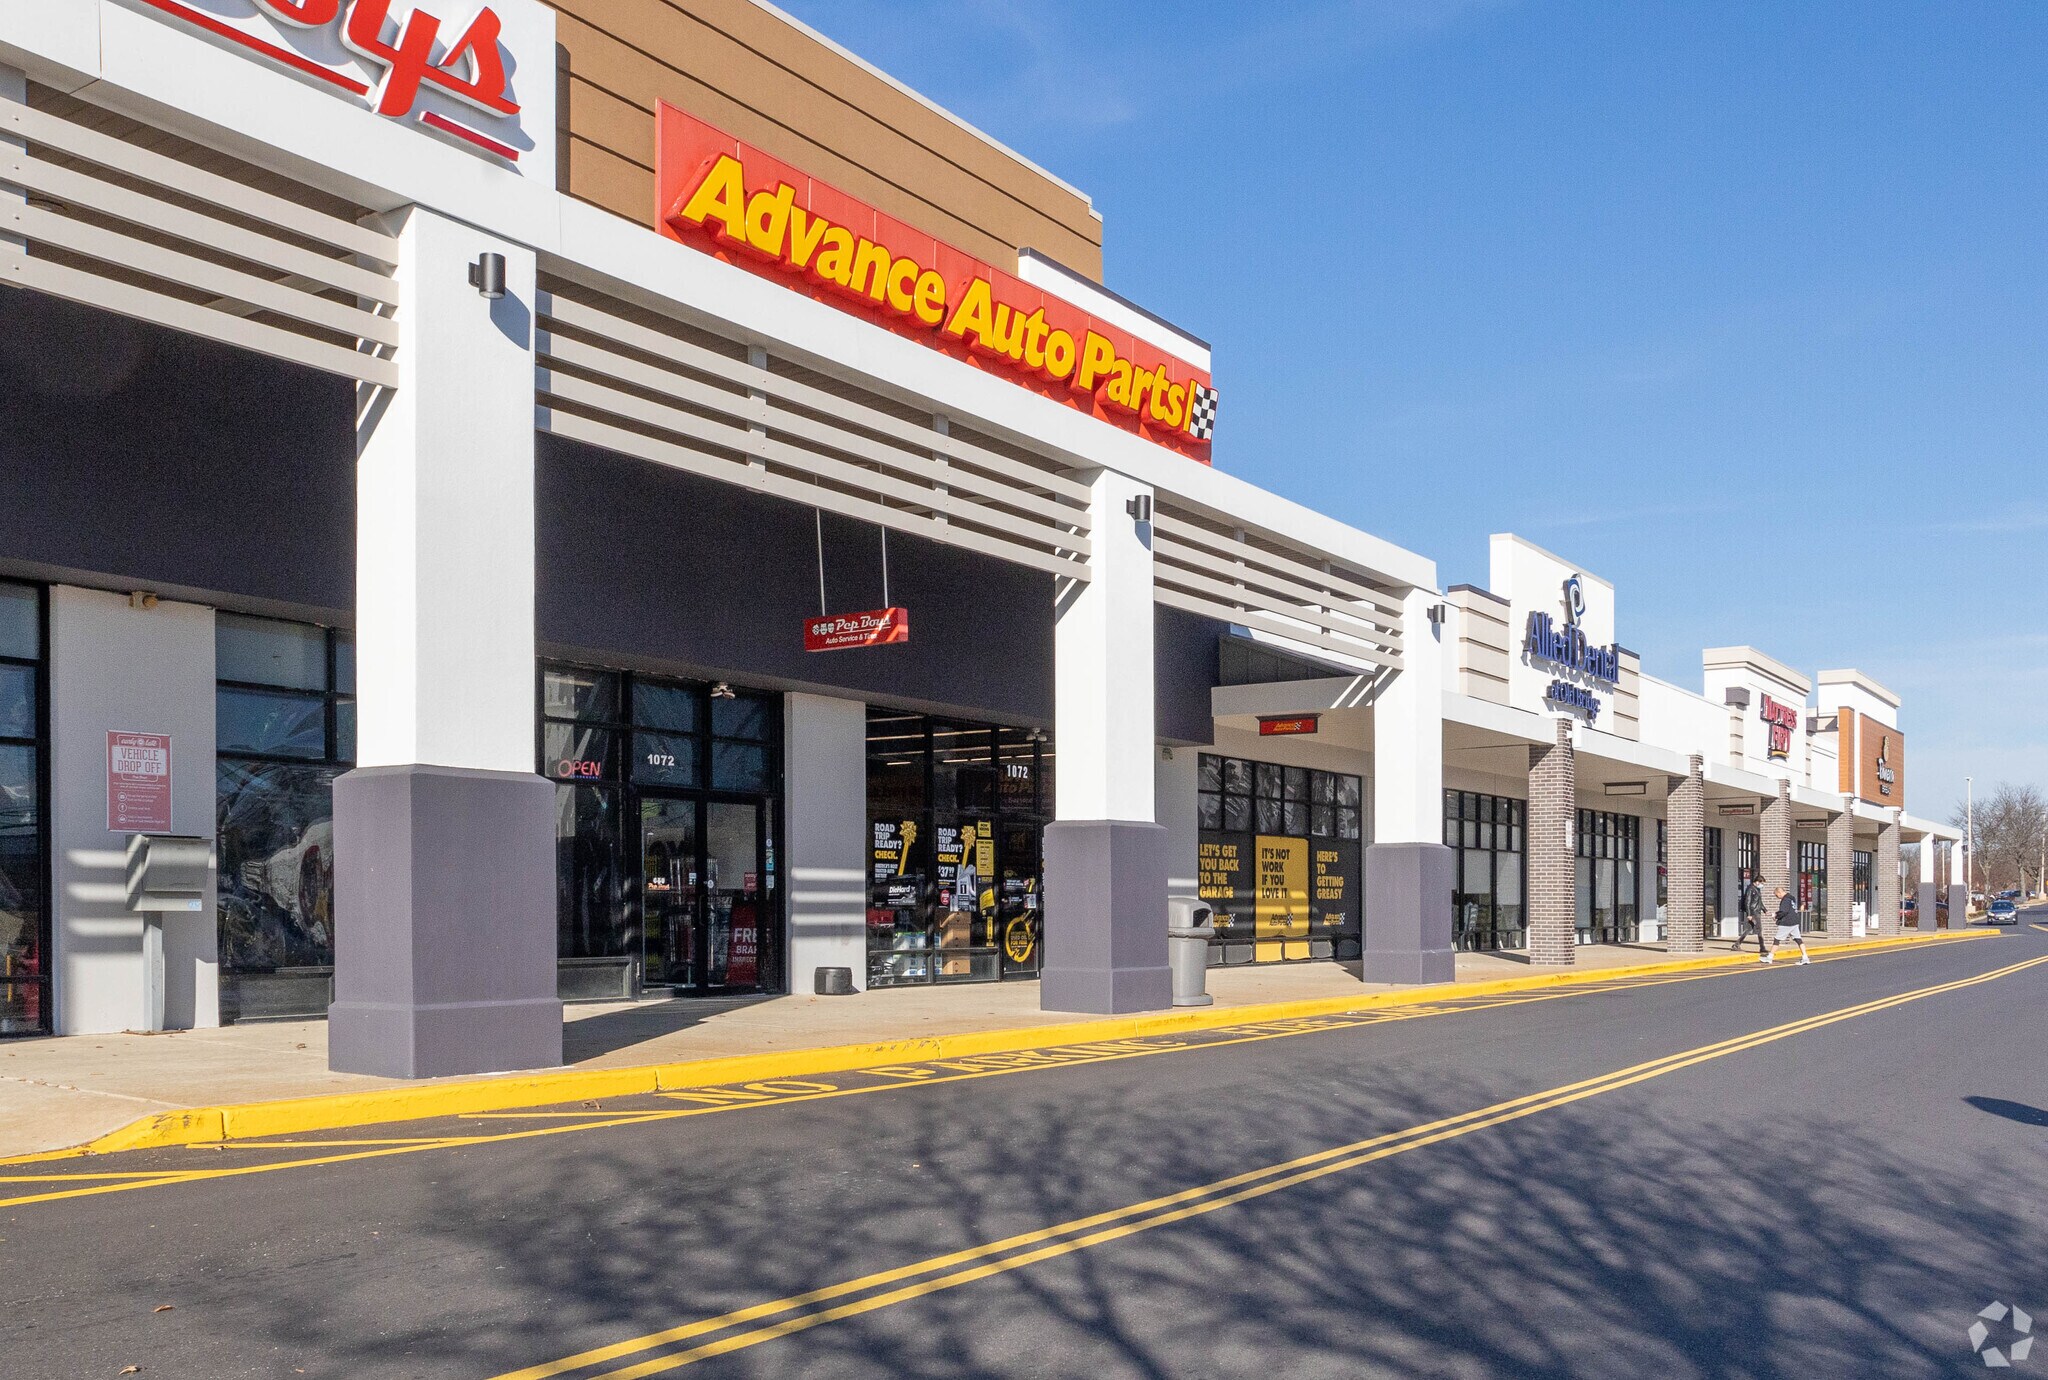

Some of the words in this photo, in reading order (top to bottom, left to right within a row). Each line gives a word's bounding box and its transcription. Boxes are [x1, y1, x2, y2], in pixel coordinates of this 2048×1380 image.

[682, 154, 947, 325] Advance
[948, 277, 1077, 380] Auto
[1079, 330, 1186, 426] Parts
[836, 618, 859, 632] Pep
[860, 615, 892, 631] Boys
[825, 636, 838, 645] Auto
[838, 633, 858, 643] Service
[1529, 611, 1573, 668] Allied
[1575, 627, 1619, 684] Dental
[120, 747, 159, 761] VEHICLE
[647, 753, 675, 767] 1072
[117, 759, 142, 772] DROP
[144, 761, 161, 773] OFF
[558, 759, 602, 777] OPEN
[1006, 764, 1029, 778] 1072
[874, 823, 896, 833] ROAD
[937, 827, 957, 837] ROAD
[874, 832, 891, 840] TRIP
[937, 836, 953, 845] TRIP
[874, 840, 903, 850] READY?
[937, 844, 963, 853] READY?
[1199, 844, 1220, 857] LET'S
[1222, 845, 1237, 858] GET
[874, 850, 899, 860] CHECK.
[937, 853, 960, 862] CHECK.
[1261, 847, 1275, 859] IT'S
[1276, 849, 1291, 860] NOT
[1316, 850, 1339, 862] HERE'S
[1200, 858, 1217, 870] YOU
[1219, 858, 1239, 871] BACK
[1261, 861, 1284, 873] WORK
[1316, 864, 1327, 875] TO
[1200, 872, 1211, 884] TO
[1212, 872, 1228, 885] THE
[1261, 874, 1268, 886] IF
[1270, 875, 1285, 886] YOU
[1316, 876, 1345, 887] GETTING
[888, 884, 912, 894] DieHard
[1200, 886, 1234, 899] GARAGE
[1261, 887, 1280, 899] LOVE
[1281, 888, 1288, 899] IT
[1316, 888, 1343, 900] GREASY
[653, 1080, 839, 1105] NO
[856, 1039, 1188, 1080] PARKING
